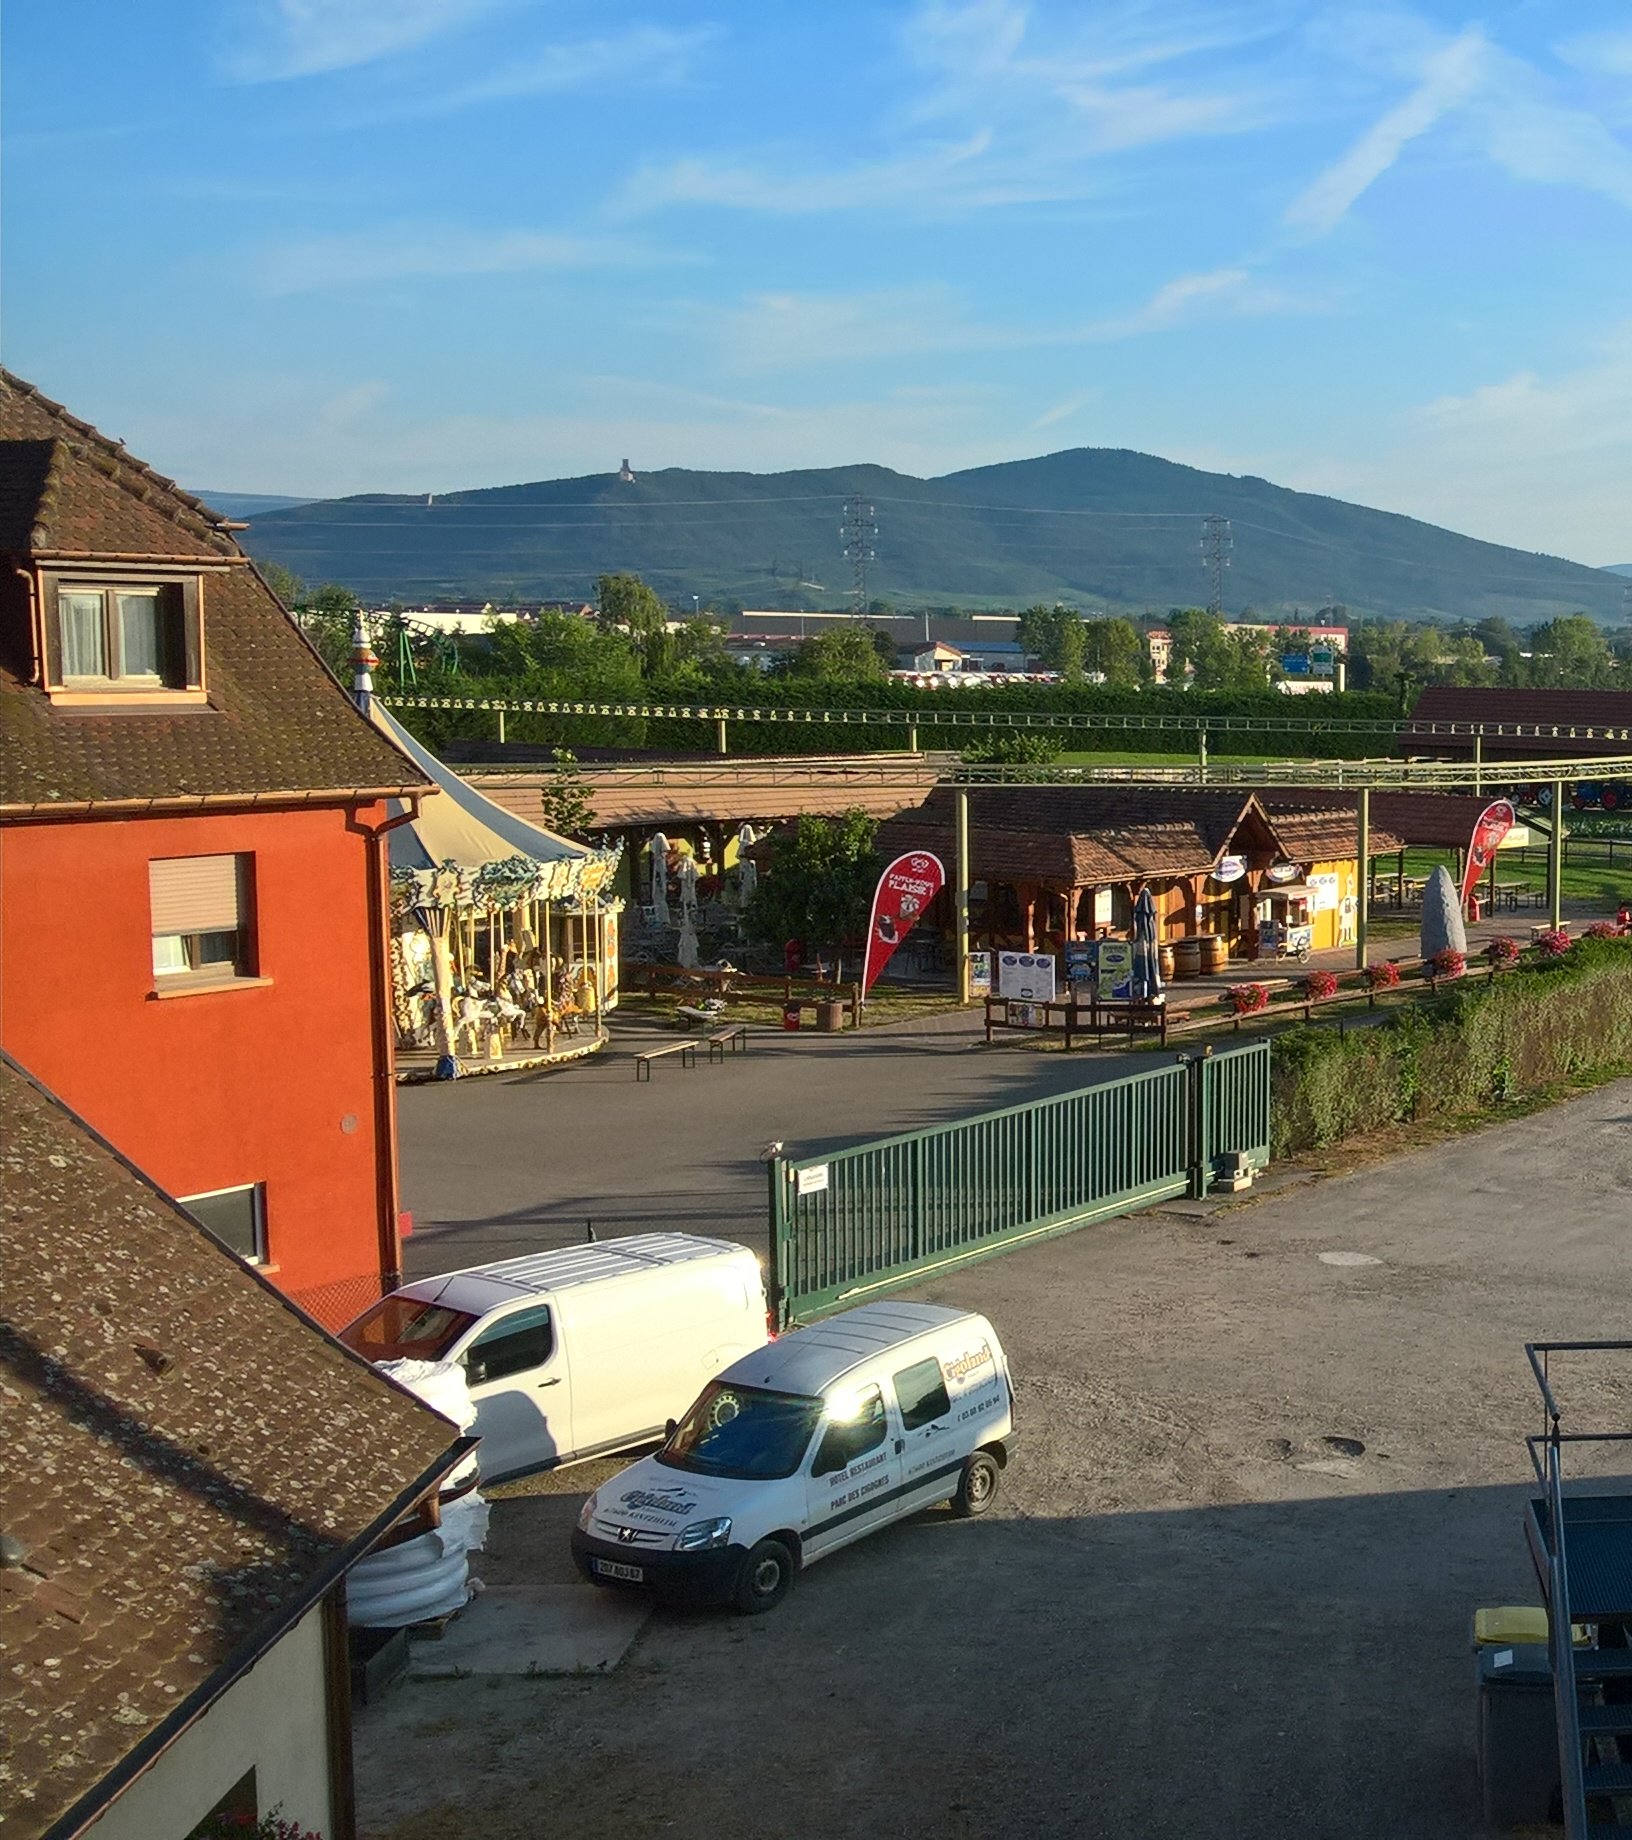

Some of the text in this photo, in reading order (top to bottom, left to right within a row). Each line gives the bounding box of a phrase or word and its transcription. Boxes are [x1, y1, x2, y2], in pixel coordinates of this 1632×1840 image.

[943, 1344, 992, 1384] Cigoland
[829, 1452, 888, 1487] HOTEL RESTAURANT
[830, 1474, 890, 1511] PARC DES CIGOGNES
